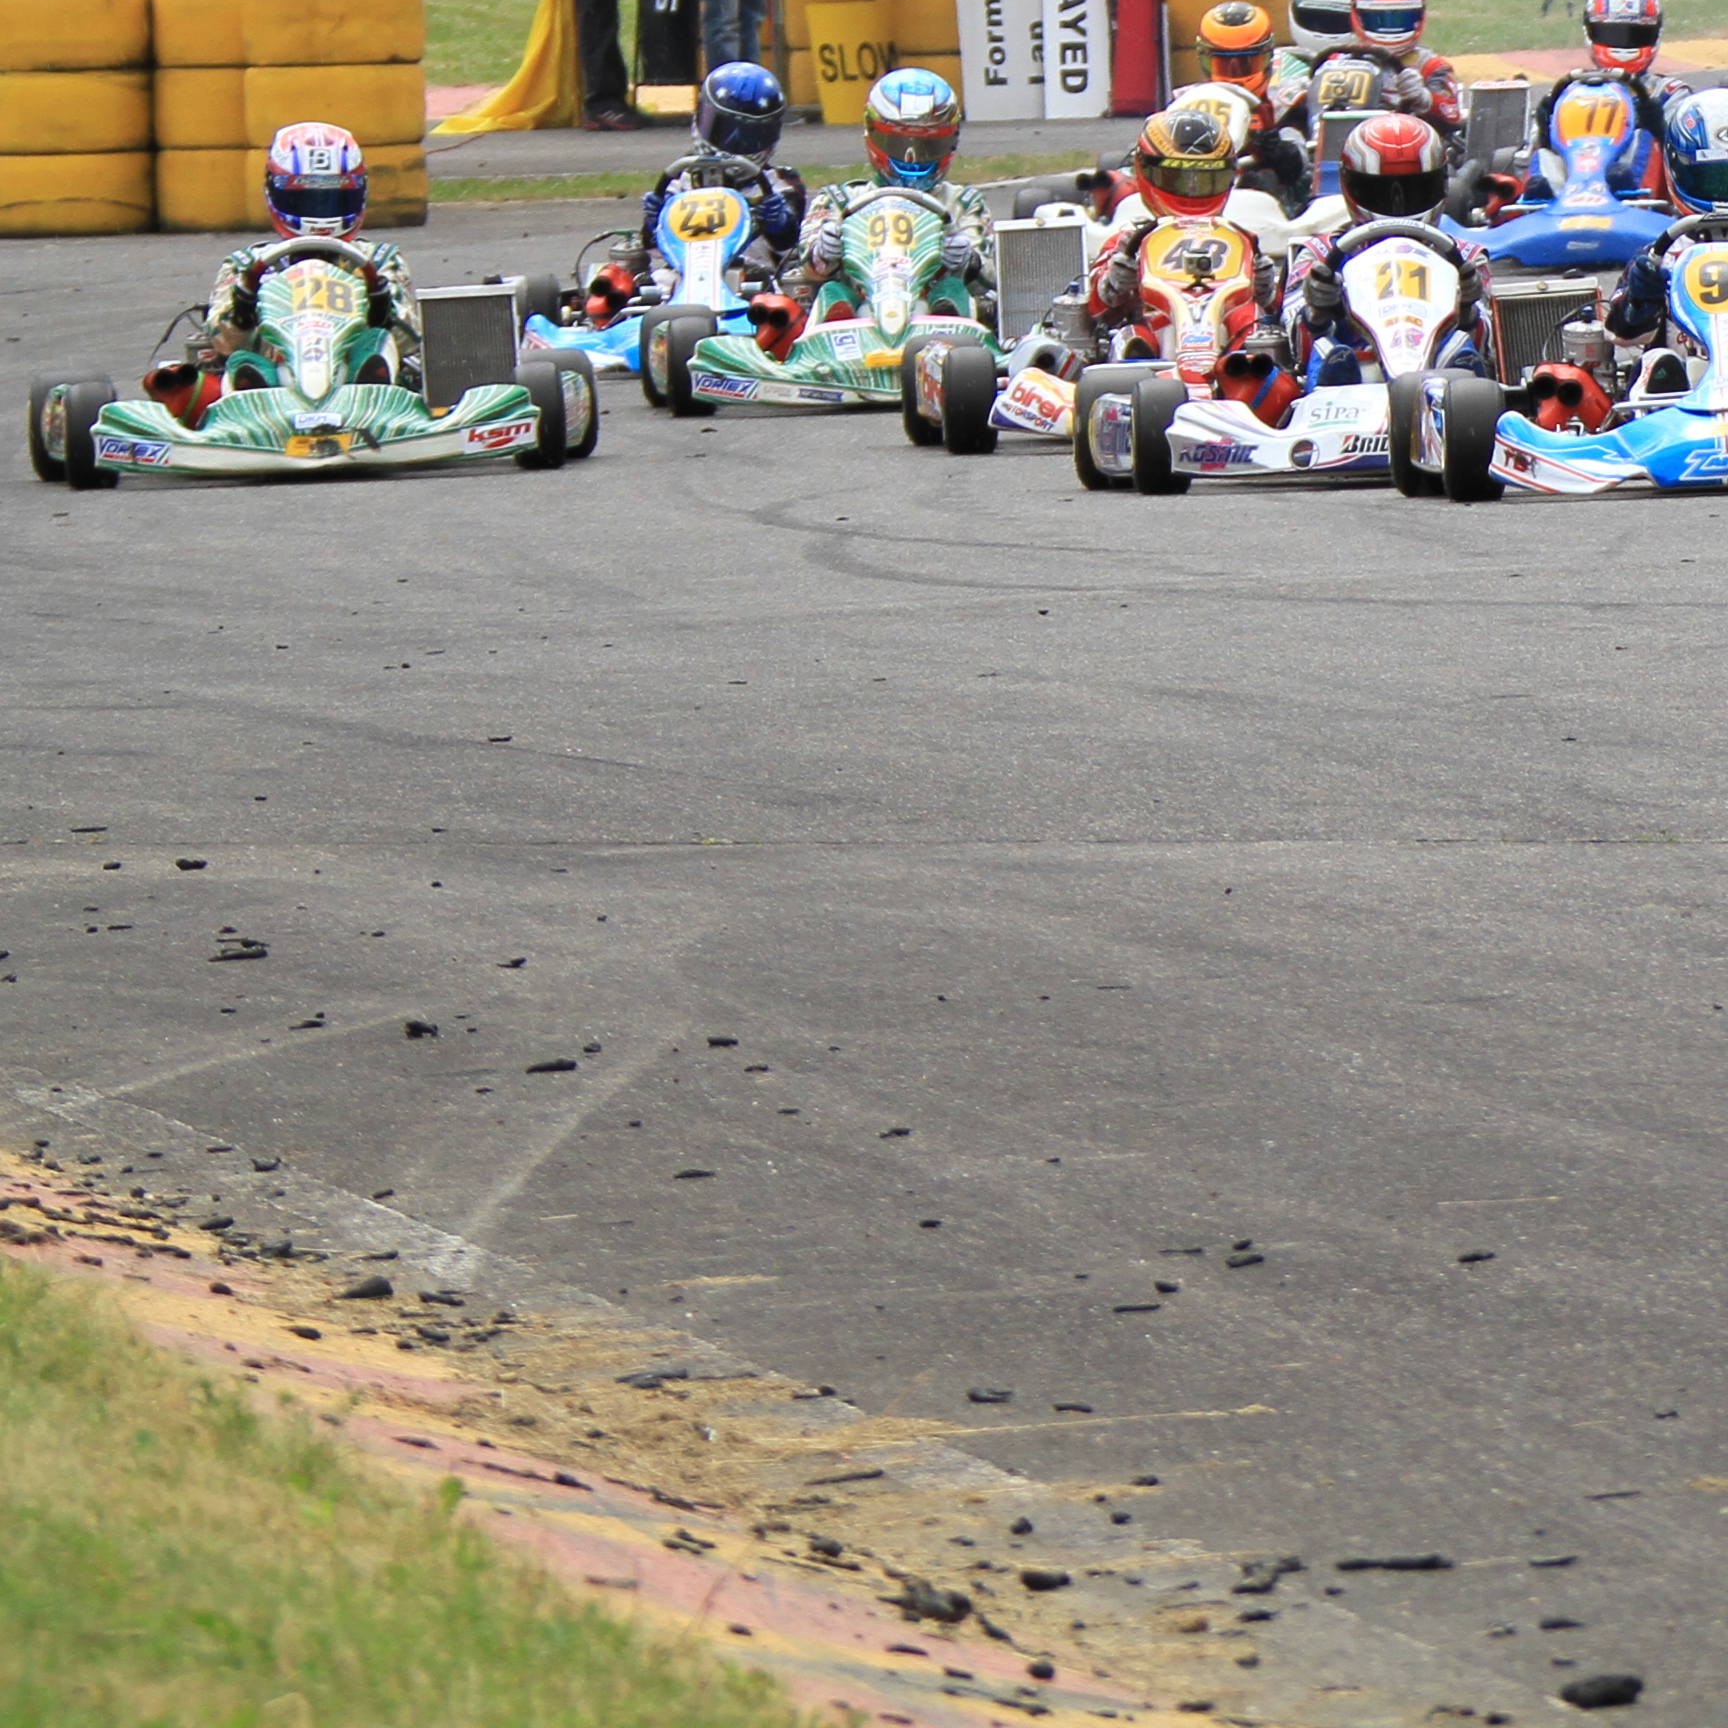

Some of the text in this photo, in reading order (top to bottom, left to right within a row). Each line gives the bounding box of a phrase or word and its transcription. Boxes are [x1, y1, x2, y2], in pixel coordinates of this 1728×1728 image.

[818, 40, 898, 82] SLOW
[679, 197, 727, 234] 23
[869, 214, 914, 248] 99
[295, 277, 351, 314] 28
[1378, 262, 1429, 301] 21
[693, 376, 757, 395] VORTEX
[1011, 382, 1063, 420] birel
[100, 438, 165, 462] VORTEX
